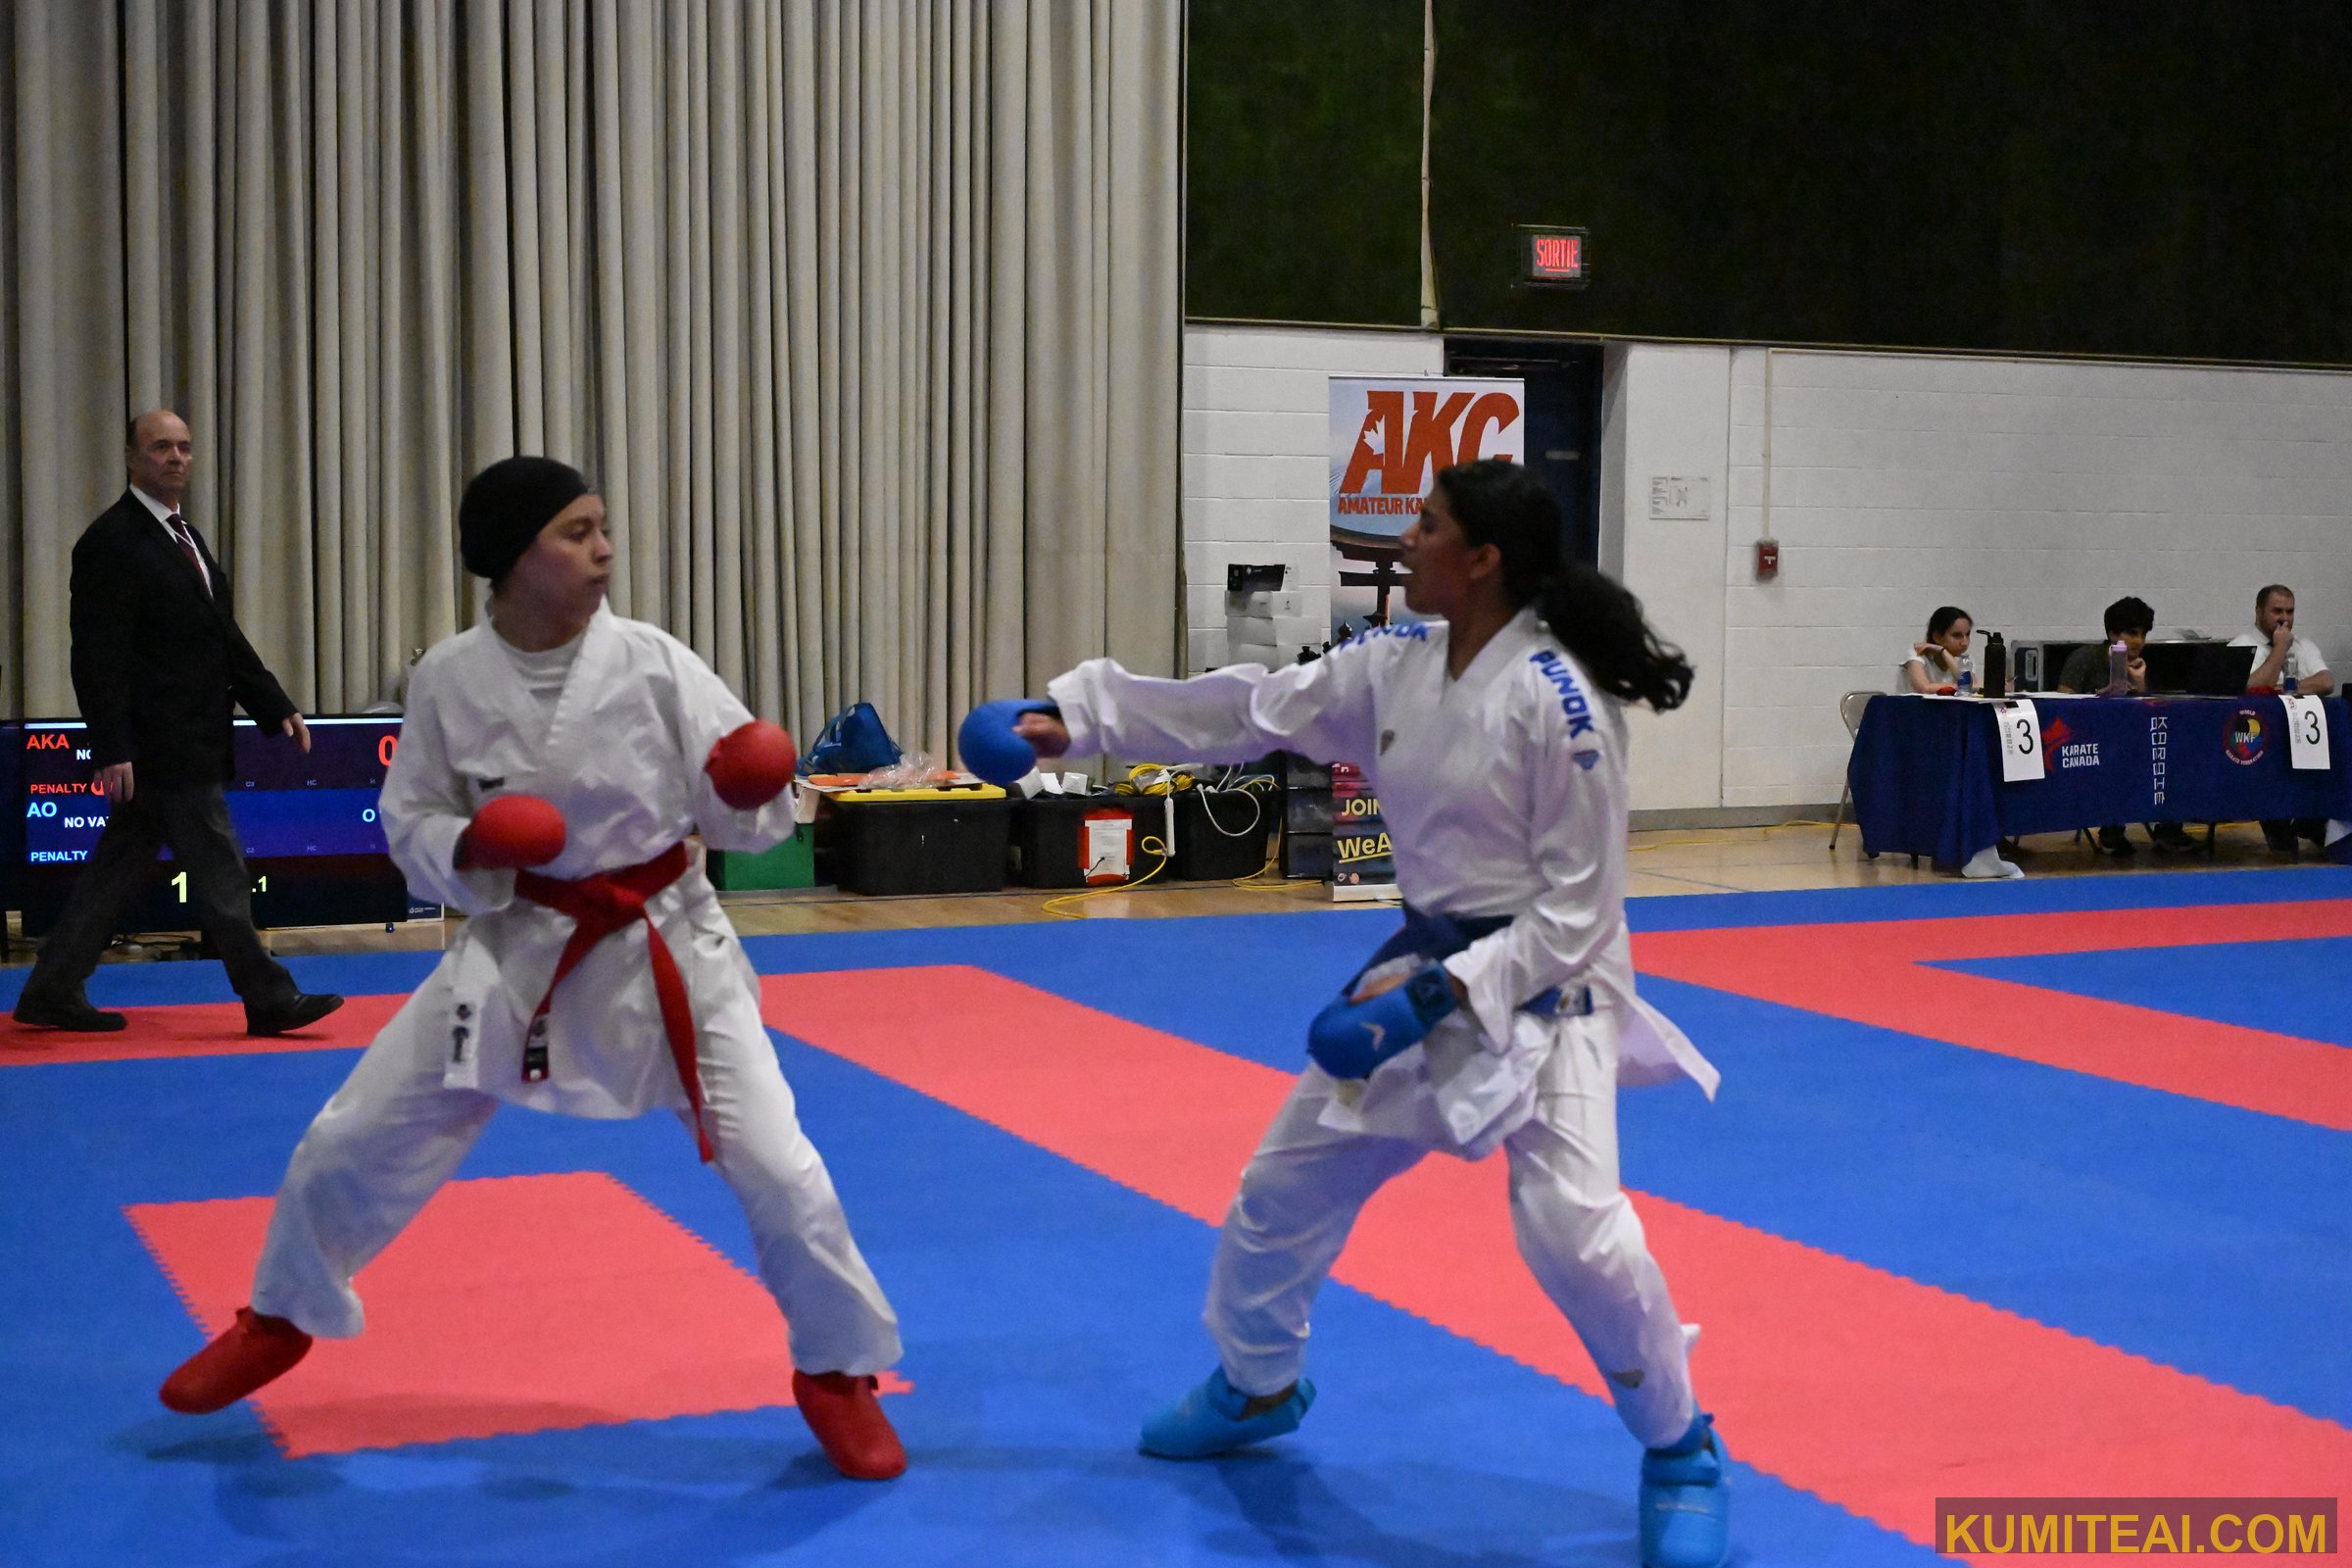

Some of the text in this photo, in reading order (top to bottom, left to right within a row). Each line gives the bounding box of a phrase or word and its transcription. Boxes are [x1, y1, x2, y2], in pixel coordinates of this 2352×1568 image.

[1536, 238, 1579, 268] SORTIE
[1339, 390, 1520, 495] AKC
[1338, 497, 1427, 515] AMATEUR KA
[1529, 649, 1596, 740] PUNOK
[2304, 710, 2321, 745] 3
[26, 733, 70, 750] AKA
[2016, 717, 2034, 755] 3
[2234, 731, 2256, 744] WKF
[2061, 743, 2099, 758] KARATE
[2062, 755, 2100, 769] CANADA
[30, 783, 87, 794] PENALTY
[26, 801, 58, 817] AO
[64, 815, 110, 828] NO VA
[30, 851, 88, 862] PENALTY
